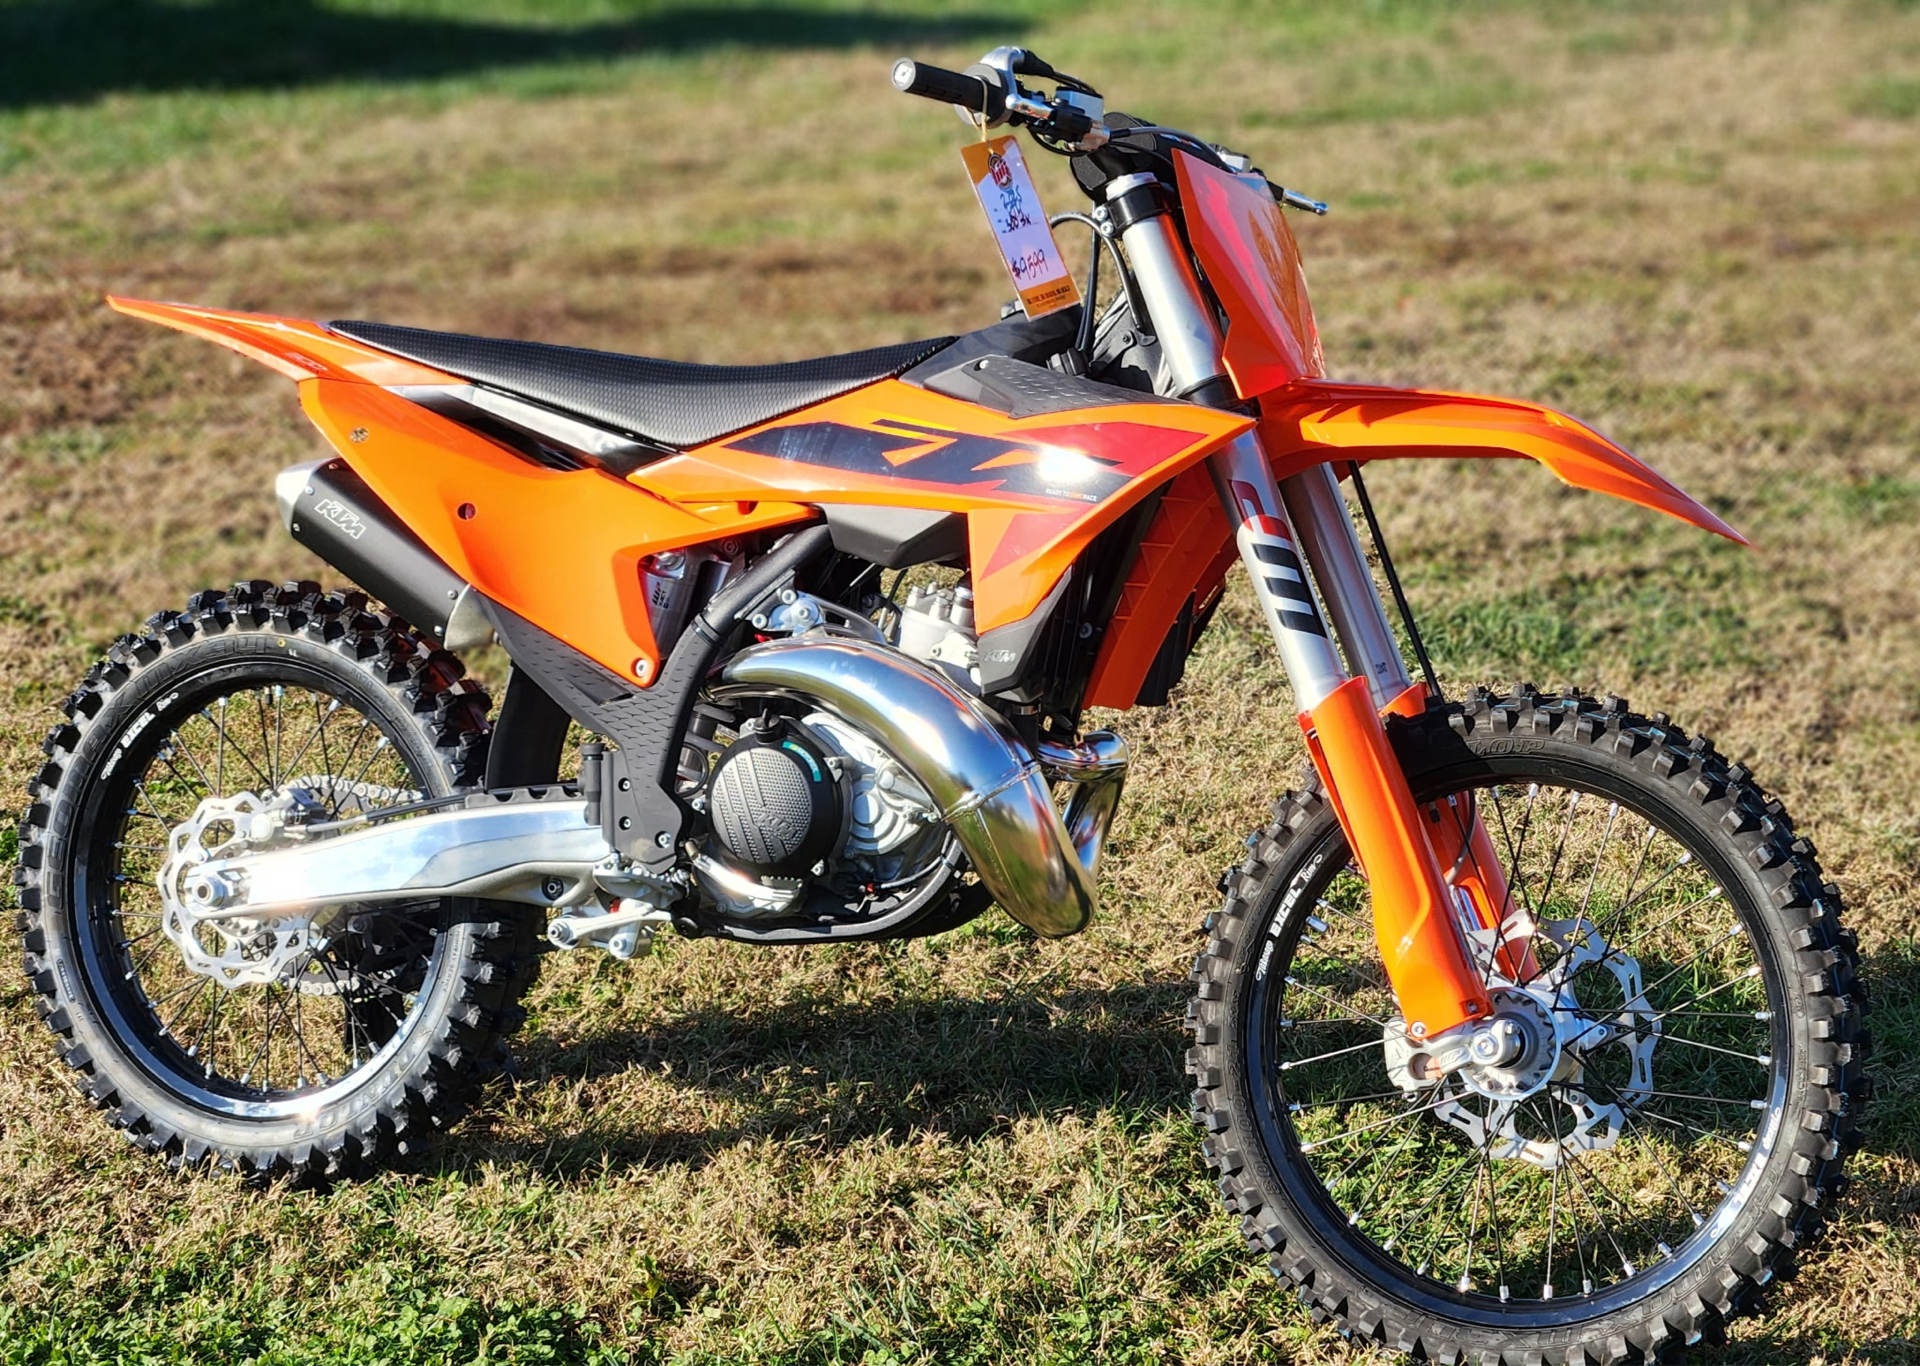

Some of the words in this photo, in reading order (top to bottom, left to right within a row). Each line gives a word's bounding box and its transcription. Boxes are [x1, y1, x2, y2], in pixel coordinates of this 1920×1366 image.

[314, 499, 367, 540] KTM
[983, 650, 1016, 663] KTM
[120, 712, 156, 748] EXCEL
[1269, 887, 1302, 938] EXCEL
